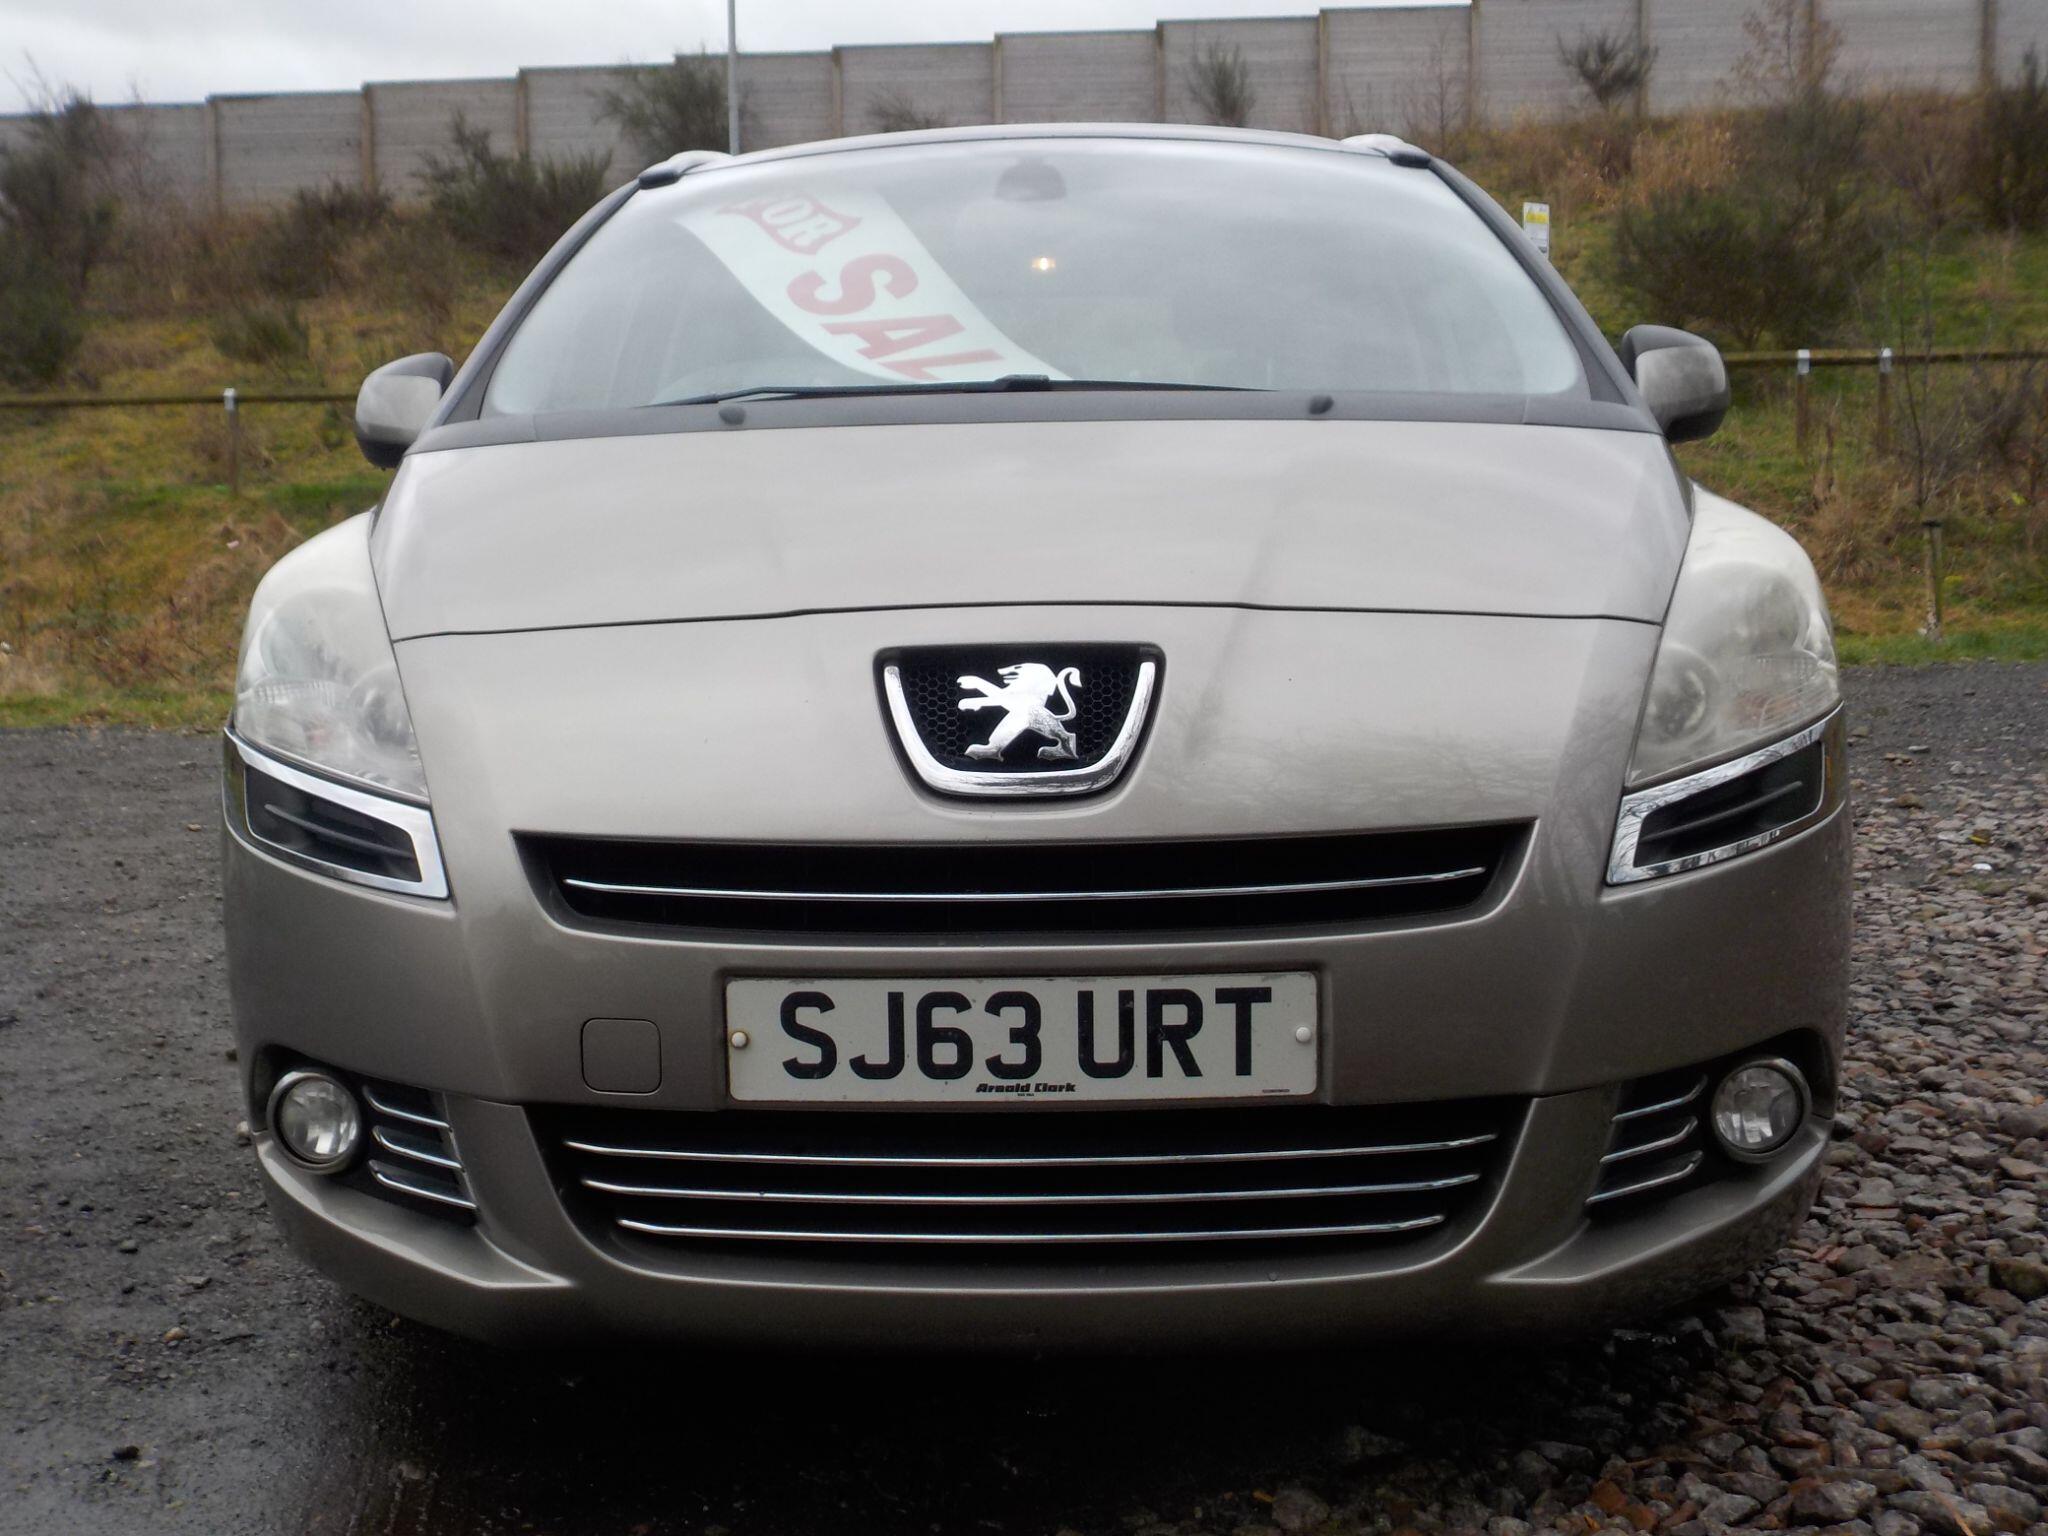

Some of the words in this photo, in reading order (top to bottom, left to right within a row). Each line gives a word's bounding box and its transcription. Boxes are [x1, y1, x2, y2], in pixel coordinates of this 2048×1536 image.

[786, 253, 1005, 381] SAL
[780, 990, 1043, 1080] SJ63
[1077, 986, 1273, 1078] URT
[976, 1083, 1031, 1093] Arnold
[1034, 1082, 1076, 1093] Clark
